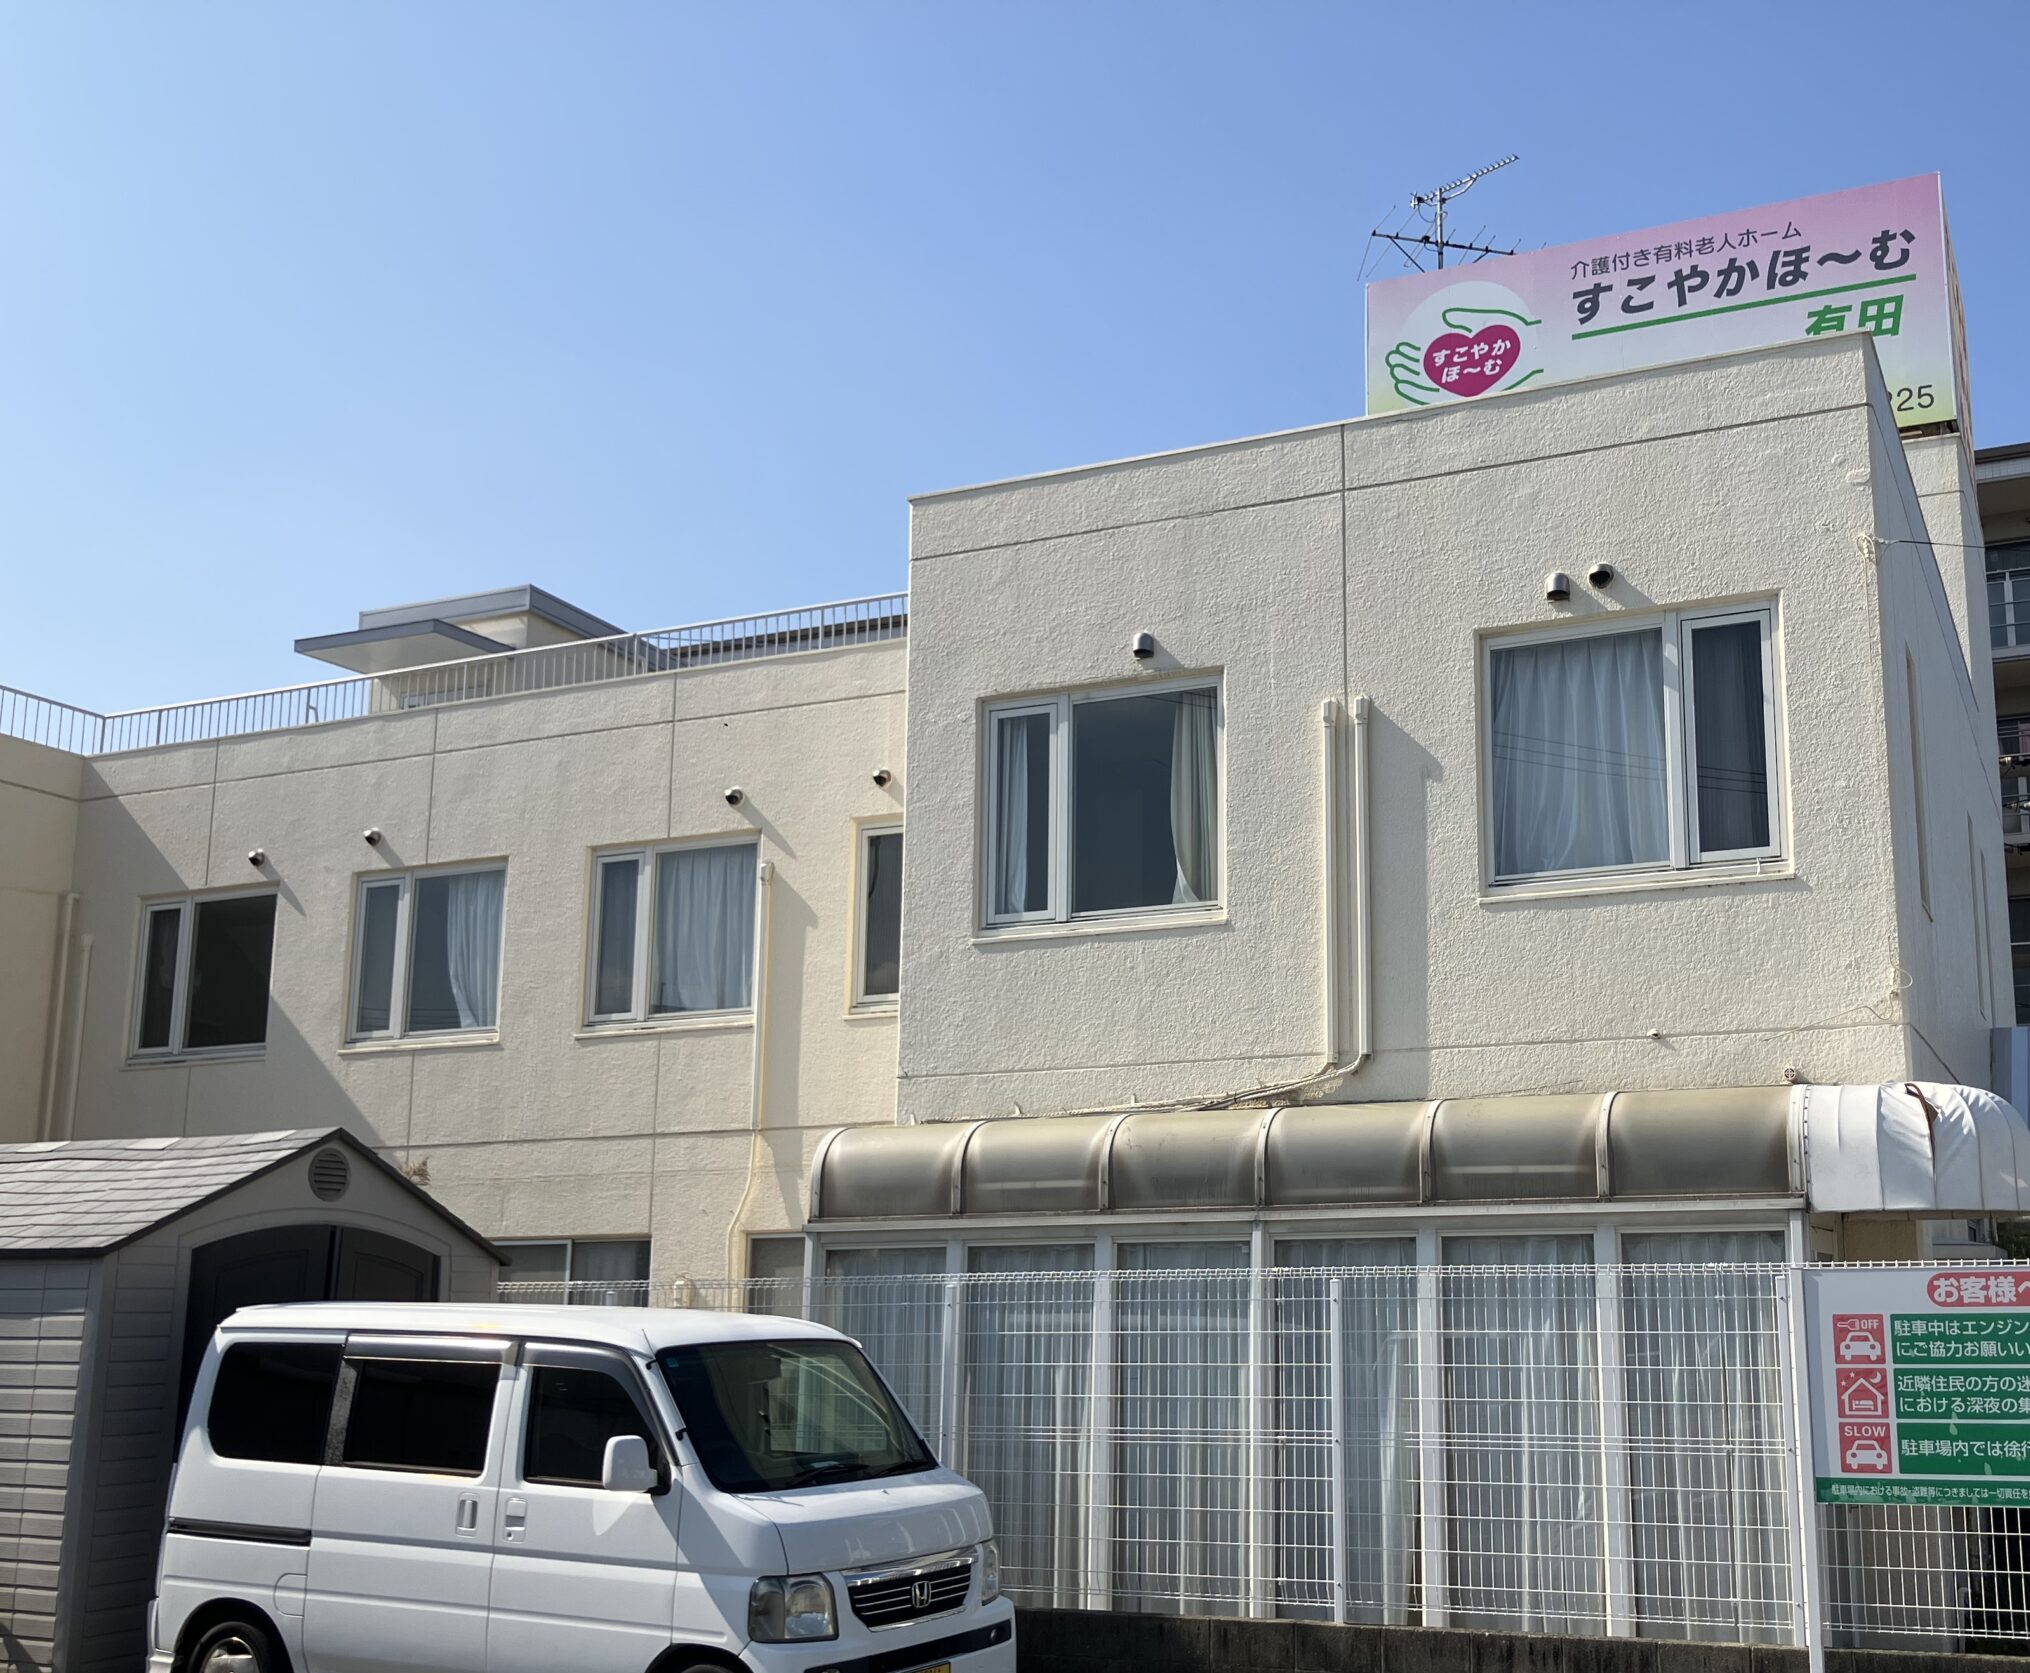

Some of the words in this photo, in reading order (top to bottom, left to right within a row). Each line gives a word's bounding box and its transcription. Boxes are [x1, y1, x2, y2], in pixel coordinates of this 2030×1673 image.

[1570, 221, 1802, 281] 介護付き有料老人ホーム
[1432, 339, 1512, 367] すこやか
[1888, 384, 1935, 413] 25
[1860, 1319, 1880, 1330] OFF
[1894, 1319, 2030, 1337] 駐車中はエンジン
[1844, 1425, 1886, 1438] SLOW
